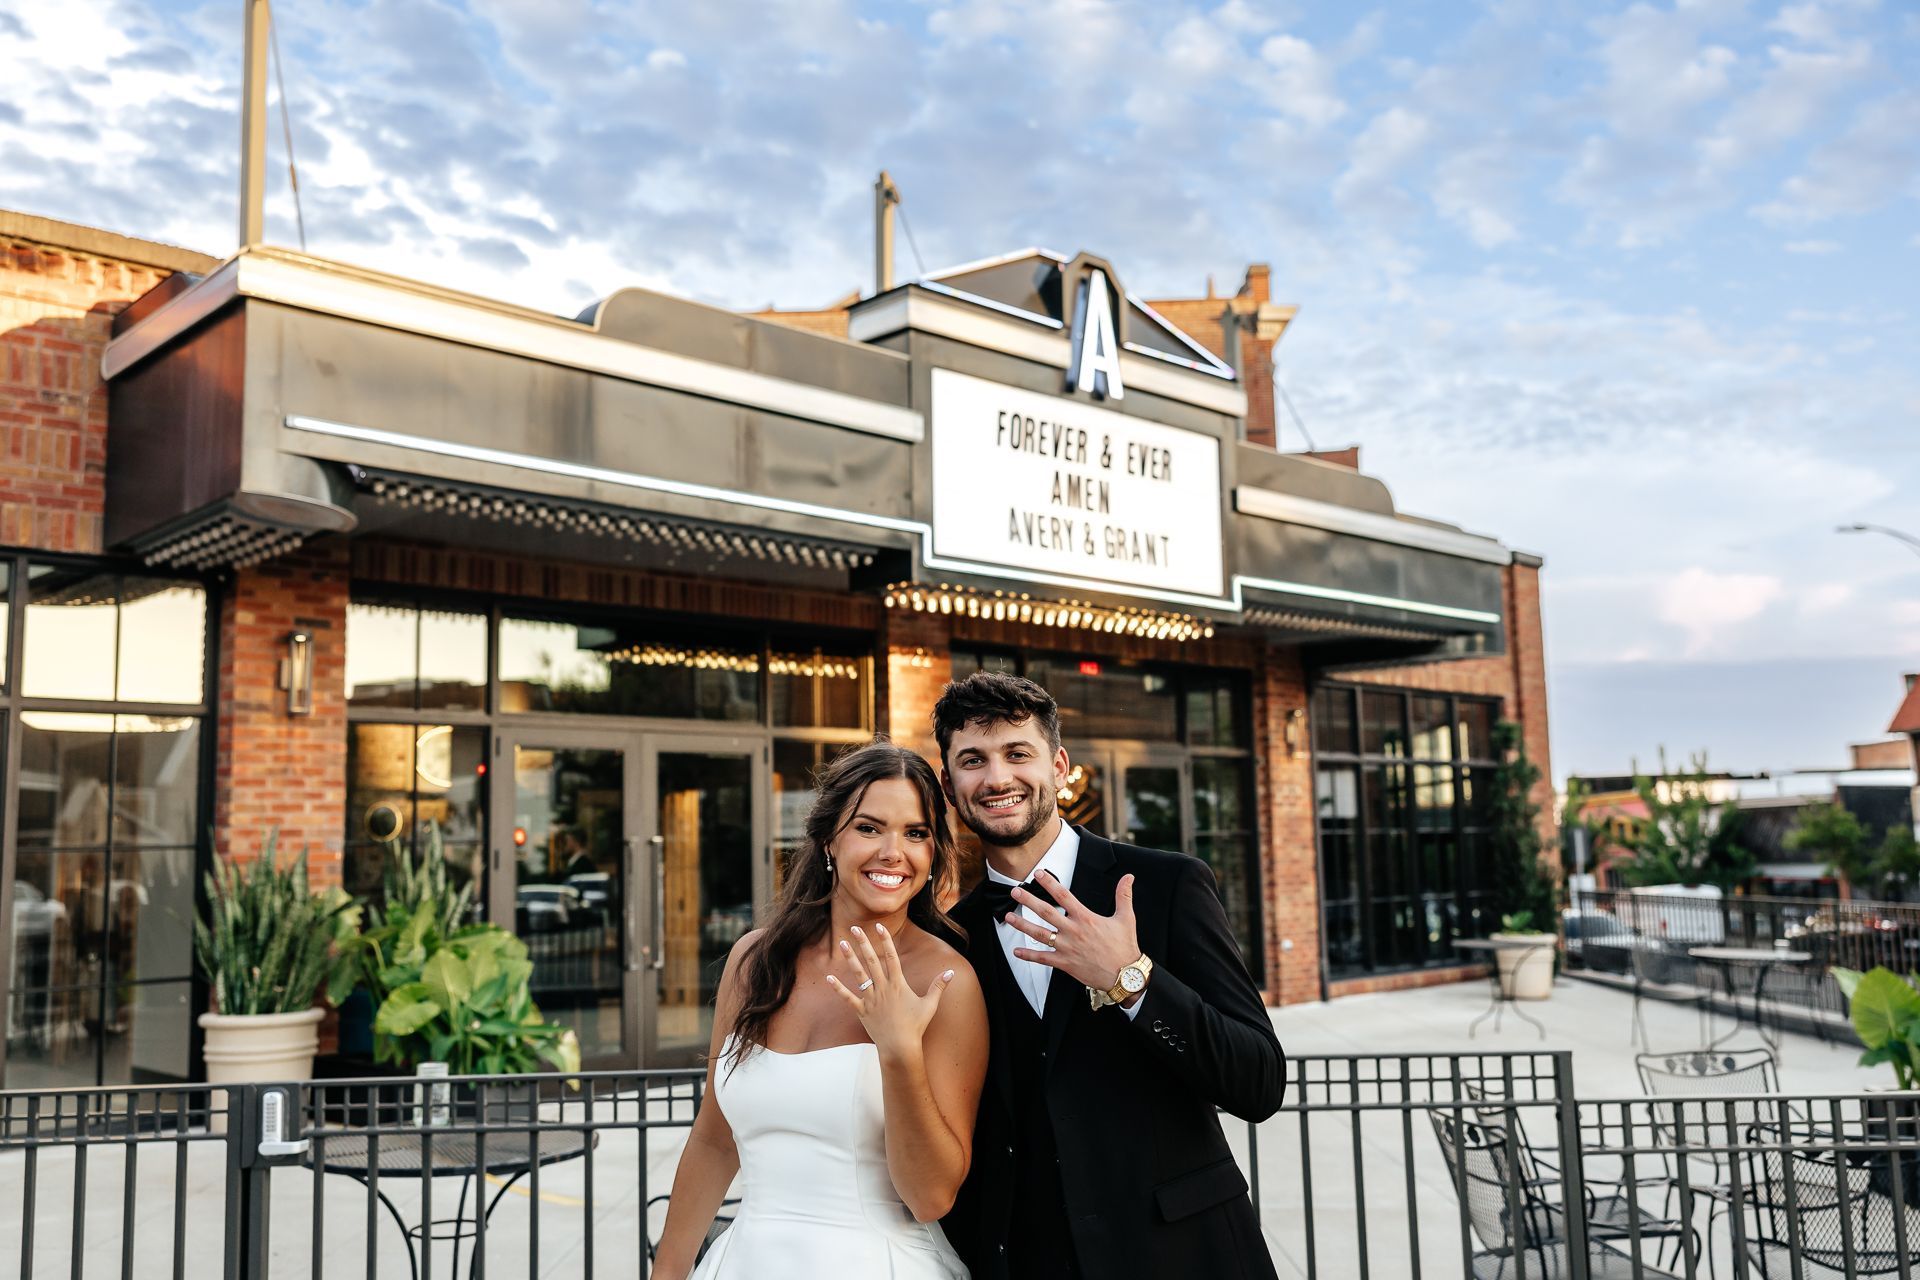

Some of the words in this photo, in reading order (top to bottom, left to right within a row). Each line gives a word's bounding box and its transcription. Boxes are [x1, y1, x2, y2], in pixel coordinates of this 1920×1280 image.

[997, 410, 1087, 464] FOREVER
[1100, 434, 1112, 469] &
[1127, 442, 1172, 482] EVER
[1051, 470, 1110, 514] AMEN
[1009, 507, 1074, 552] AVERY
[1084, 522, 1095, 555] &
[1104, 525, 1169, 568] GRANT
